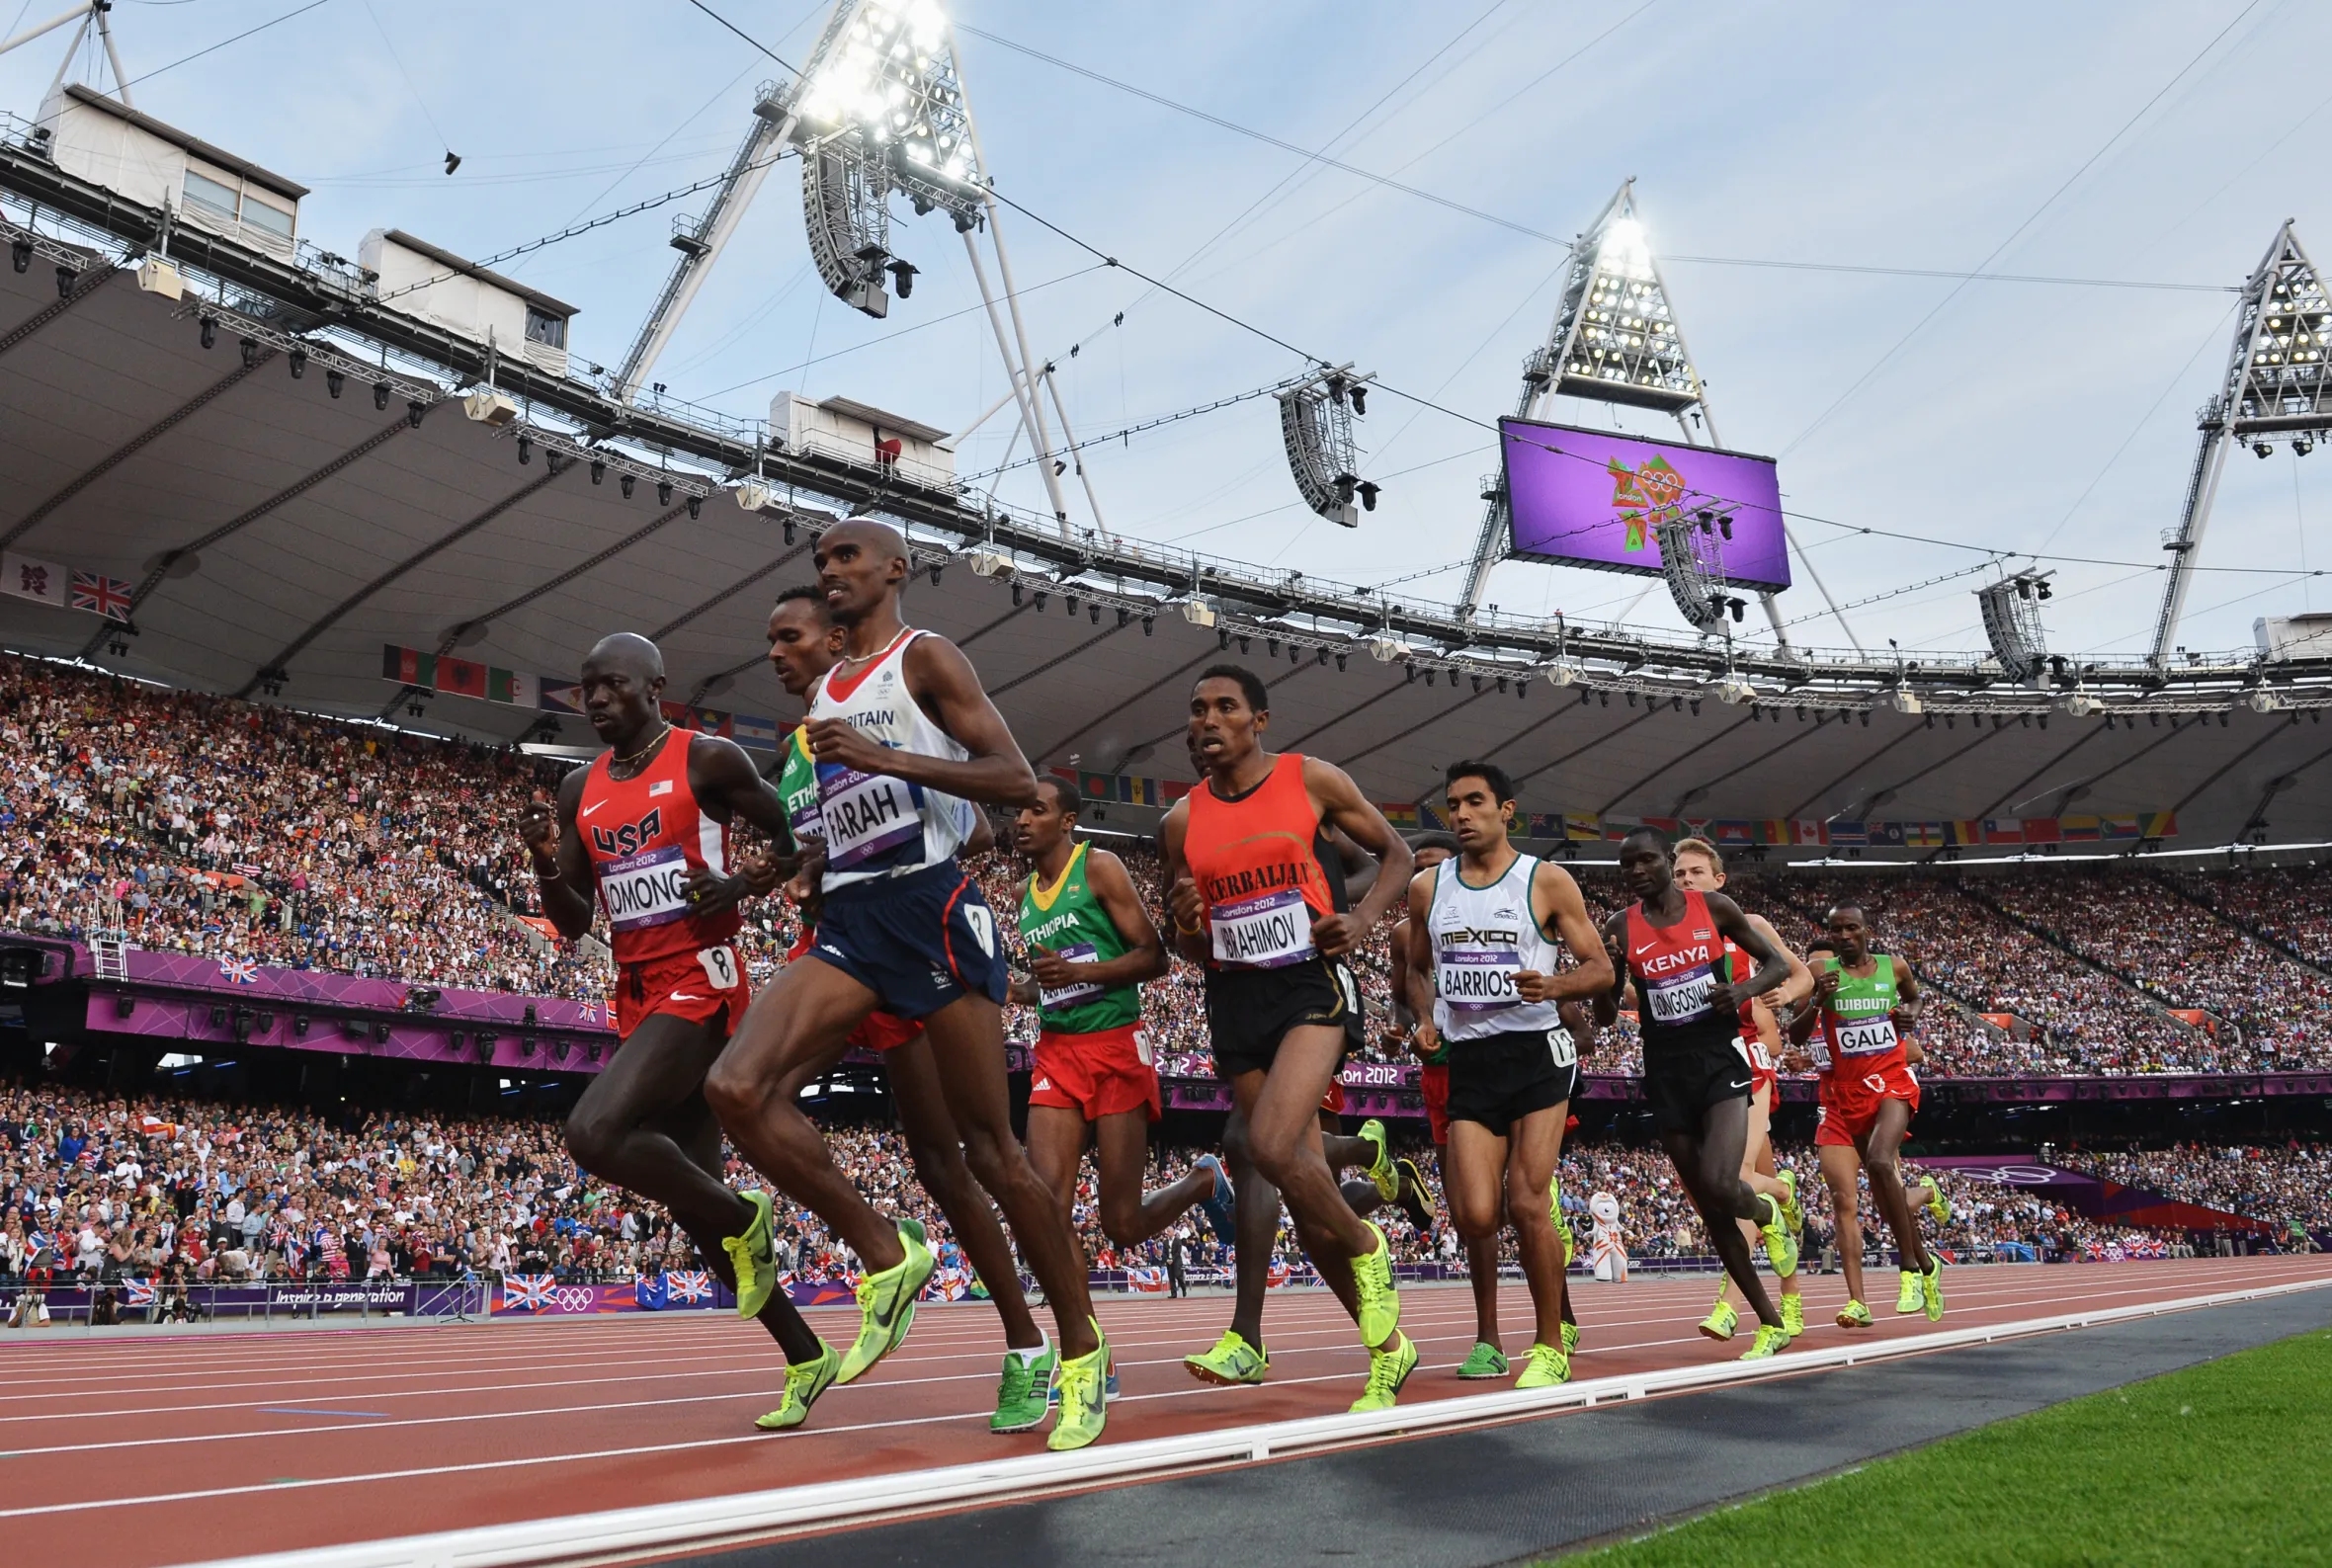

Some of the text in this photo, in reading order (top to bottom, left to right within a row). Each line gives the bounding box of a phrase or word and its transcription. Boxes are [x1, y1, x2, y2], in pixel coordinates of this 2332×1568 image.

[826, 784, 900, 847] FARAH
[592, 806, 662, 858] USA
[609, 854, 657, 872] London 2012
[1222, 897, 1276, 918] London 2012
[1026, 912, 1080, 948] ETHIOPIA
[1220, 912, 1296, 959] IBRAHIMOV
[1441, 927, 1518, 948] MEXICO
[1060, 949, 1074, 958] 2012
[1455, 954, 1498, 963] London 2012
[1641, 945, 1709, 976] KENYA
[711, 949, 730, 983] 8
[1680, 971, 1696, 982] 2012
[1445, 970, 1513, 997] BARRIOS
[1834, 997, 1890, 1012] DJIBOUTI
[1550, 1032, 1576, 1062] 12
[1840, 1025, 1895, 1049] GALA
[1154, 1054, 1191, 1076] 212
[1342, 1066, 1398, 1085] on 2012
[276, 1286, 406, 1310] Inspire a generation
